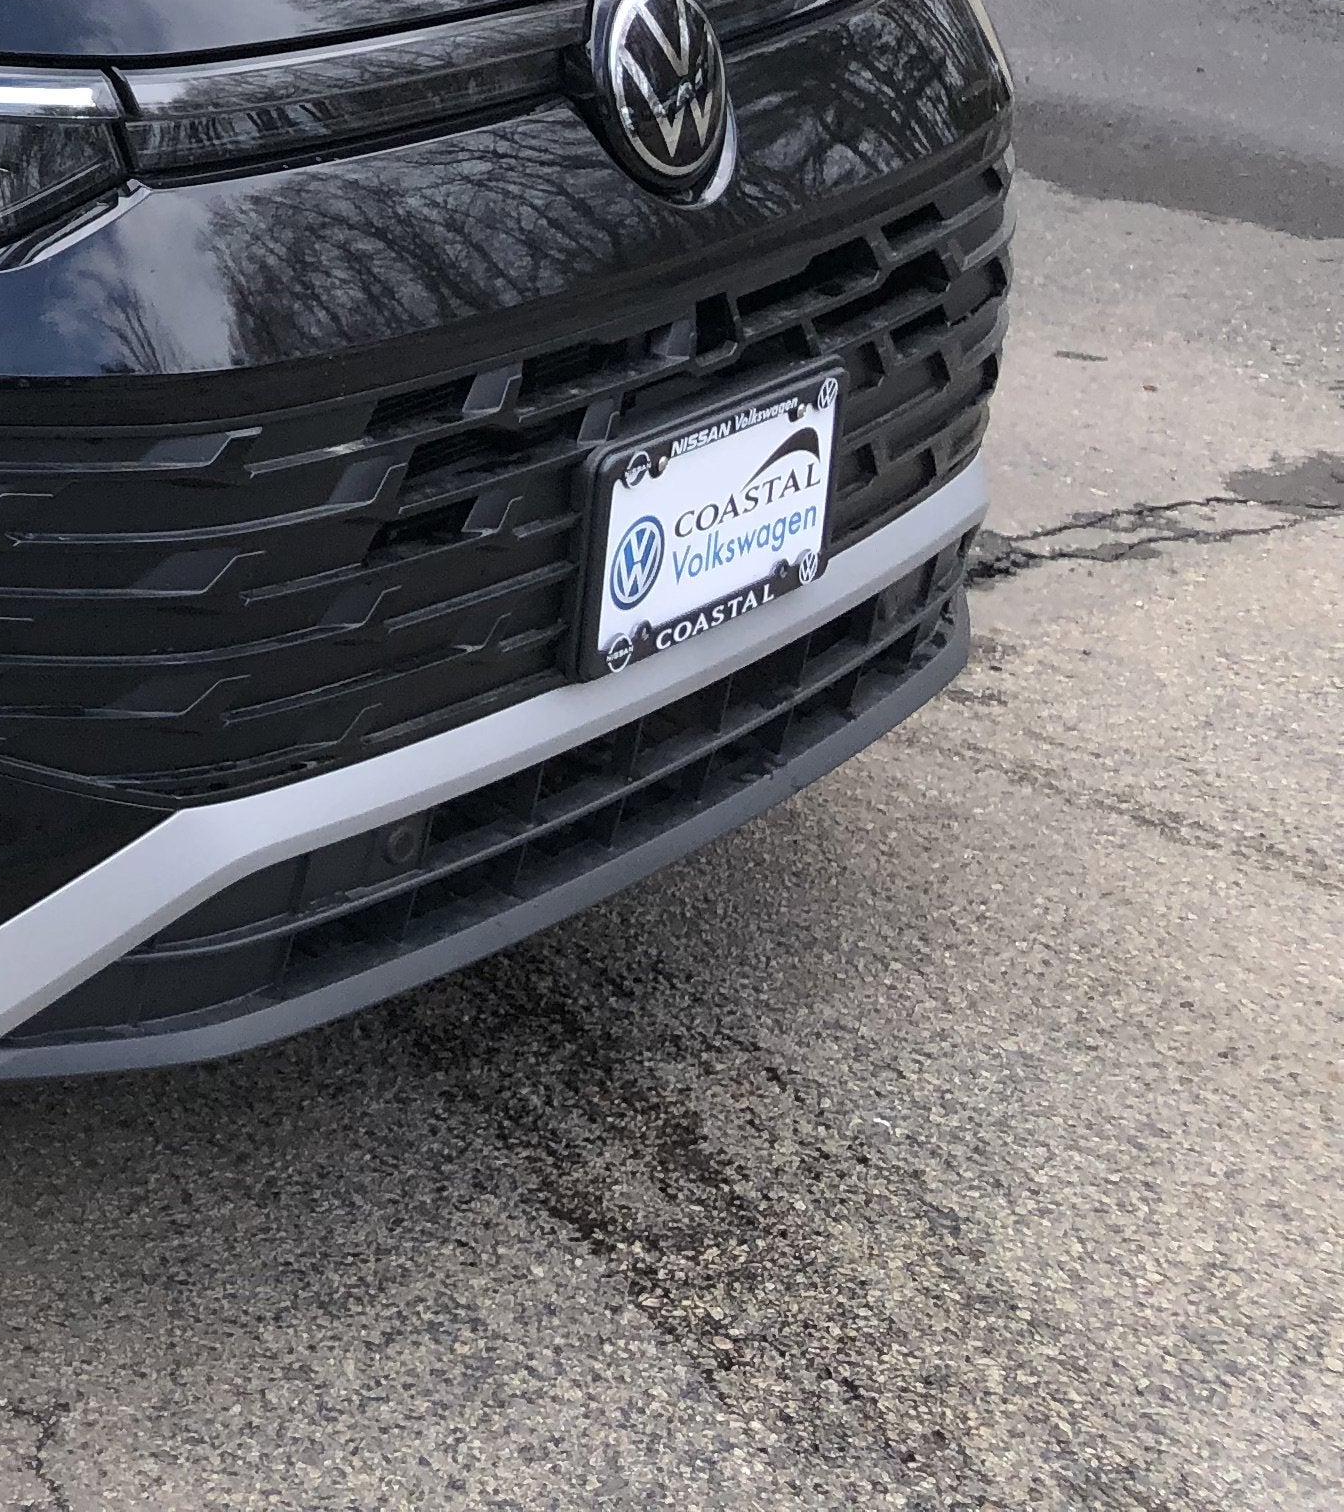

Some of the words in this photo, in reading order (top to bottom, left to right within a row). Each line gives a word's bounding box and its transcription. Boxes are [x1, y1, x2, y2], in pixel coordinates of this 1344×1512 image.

[670, 420, 731, 457] NISSAN
[734, 396, 799, 431] Volkswagen
[673, 461, 822, 538] COASTAL
[671, 505, 818, 585] Volkswagen
[655, 584, 775, 650] COASTAL
